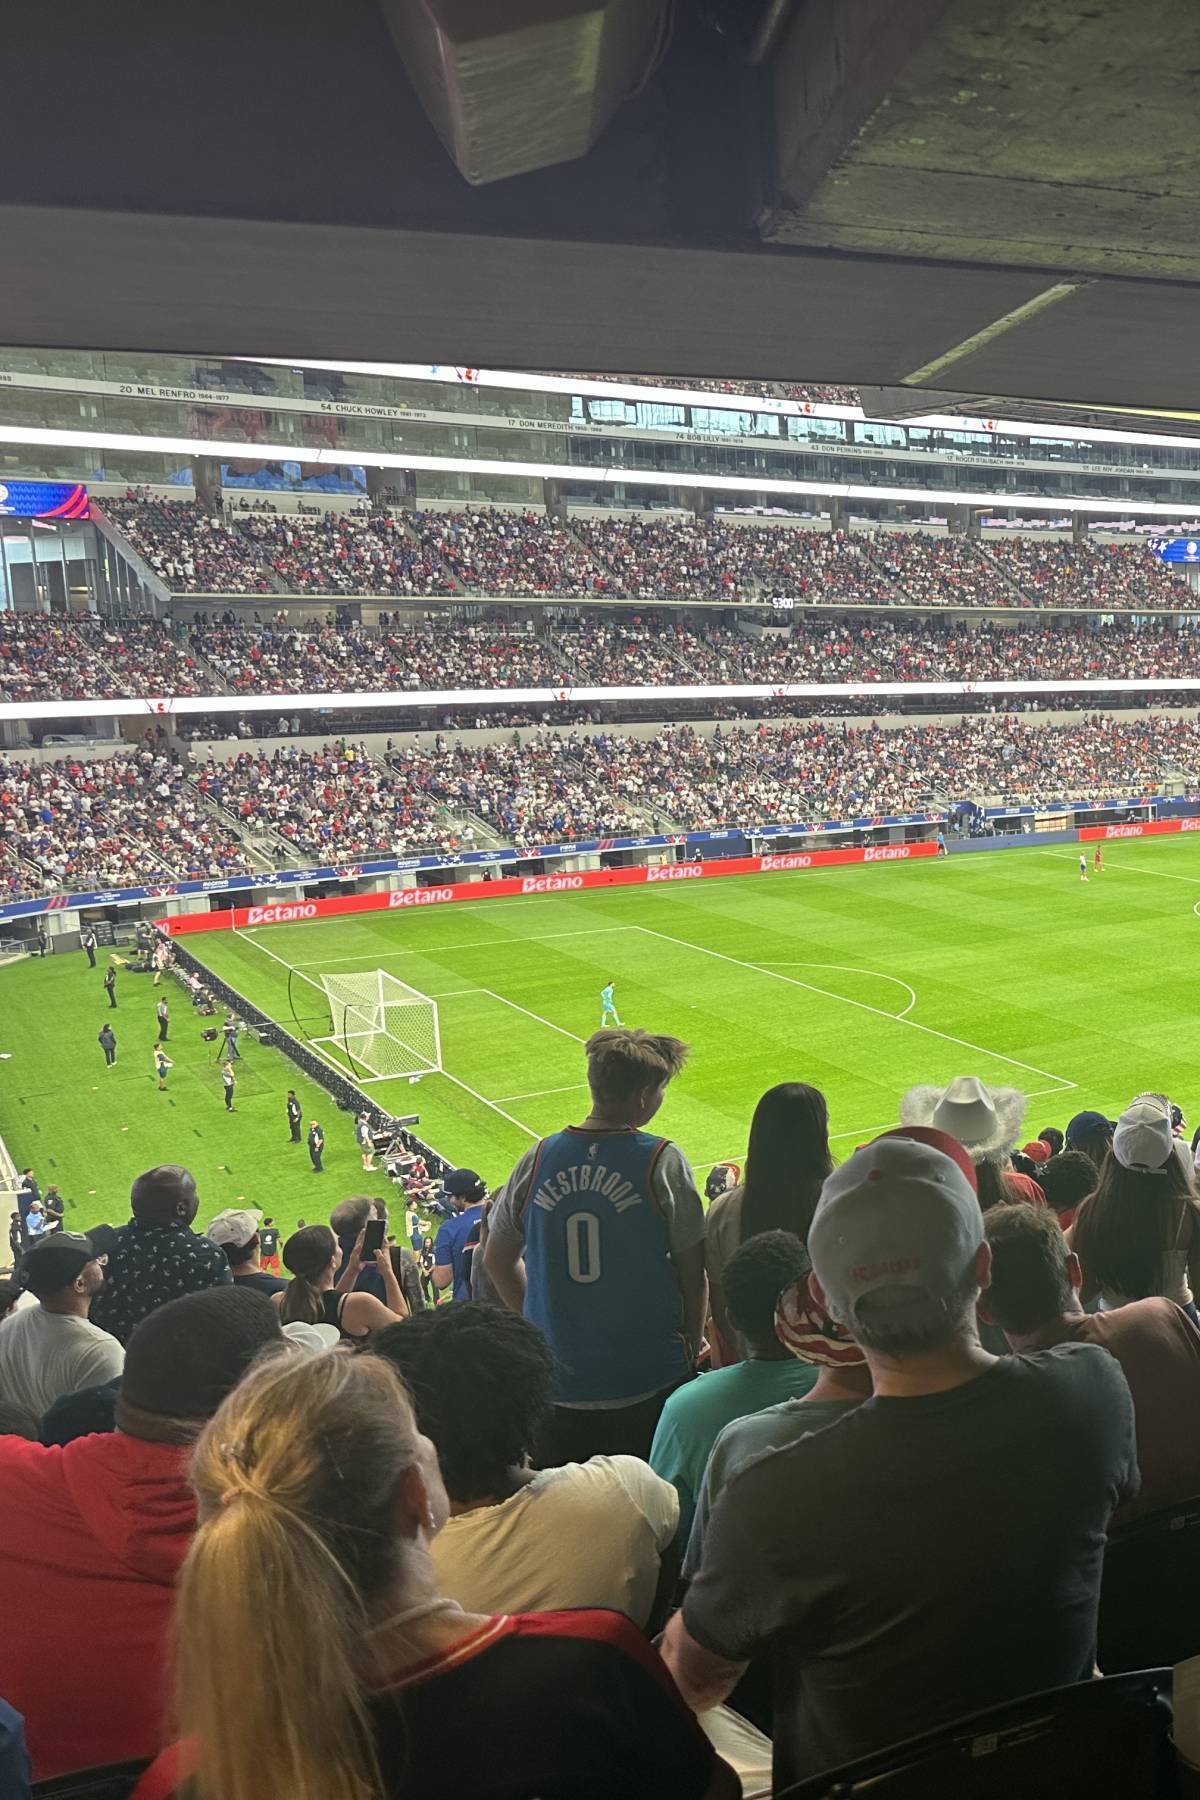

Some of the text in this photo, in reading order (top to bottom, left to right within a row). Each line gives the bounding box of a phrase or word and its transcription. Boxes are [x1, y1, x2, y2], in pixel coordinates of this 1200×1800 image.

[120, 385, 133, 394] 20
[138, 387, 157, 396] MEL
[159, 389, 196, 399] RENFRO
[336, 405, 363, 414] CHUCK
[365, 407, 398, 417] HOWLEY
[519, 420, 535, 428] DON
[537, 422, 573, 431] MEREDITH
[675, 432, 685, 440] 74
[687, 433, 702, 441] BOB
[703, 434, 720, 442] LILLY
[836, 446, 862, 455] PERKINS
[956, 456, 975, 464] ROGER
[976, 457, 1004, 465] STAUBACH
[1106, 825, 1143, 838] Betano
[760, 853, 811, 870] Betano
[864, 844, 910, 862] Betano
[647, 864, 703, 881] Betano
[522, 874, 583, 893] Betano
[389, 887, 453, 907] Betano
[247, 903, 316, 924] Betano
[533, 1164, 643, 1213] WESTBROOK
[566, 1212, 601, 1284] 0
